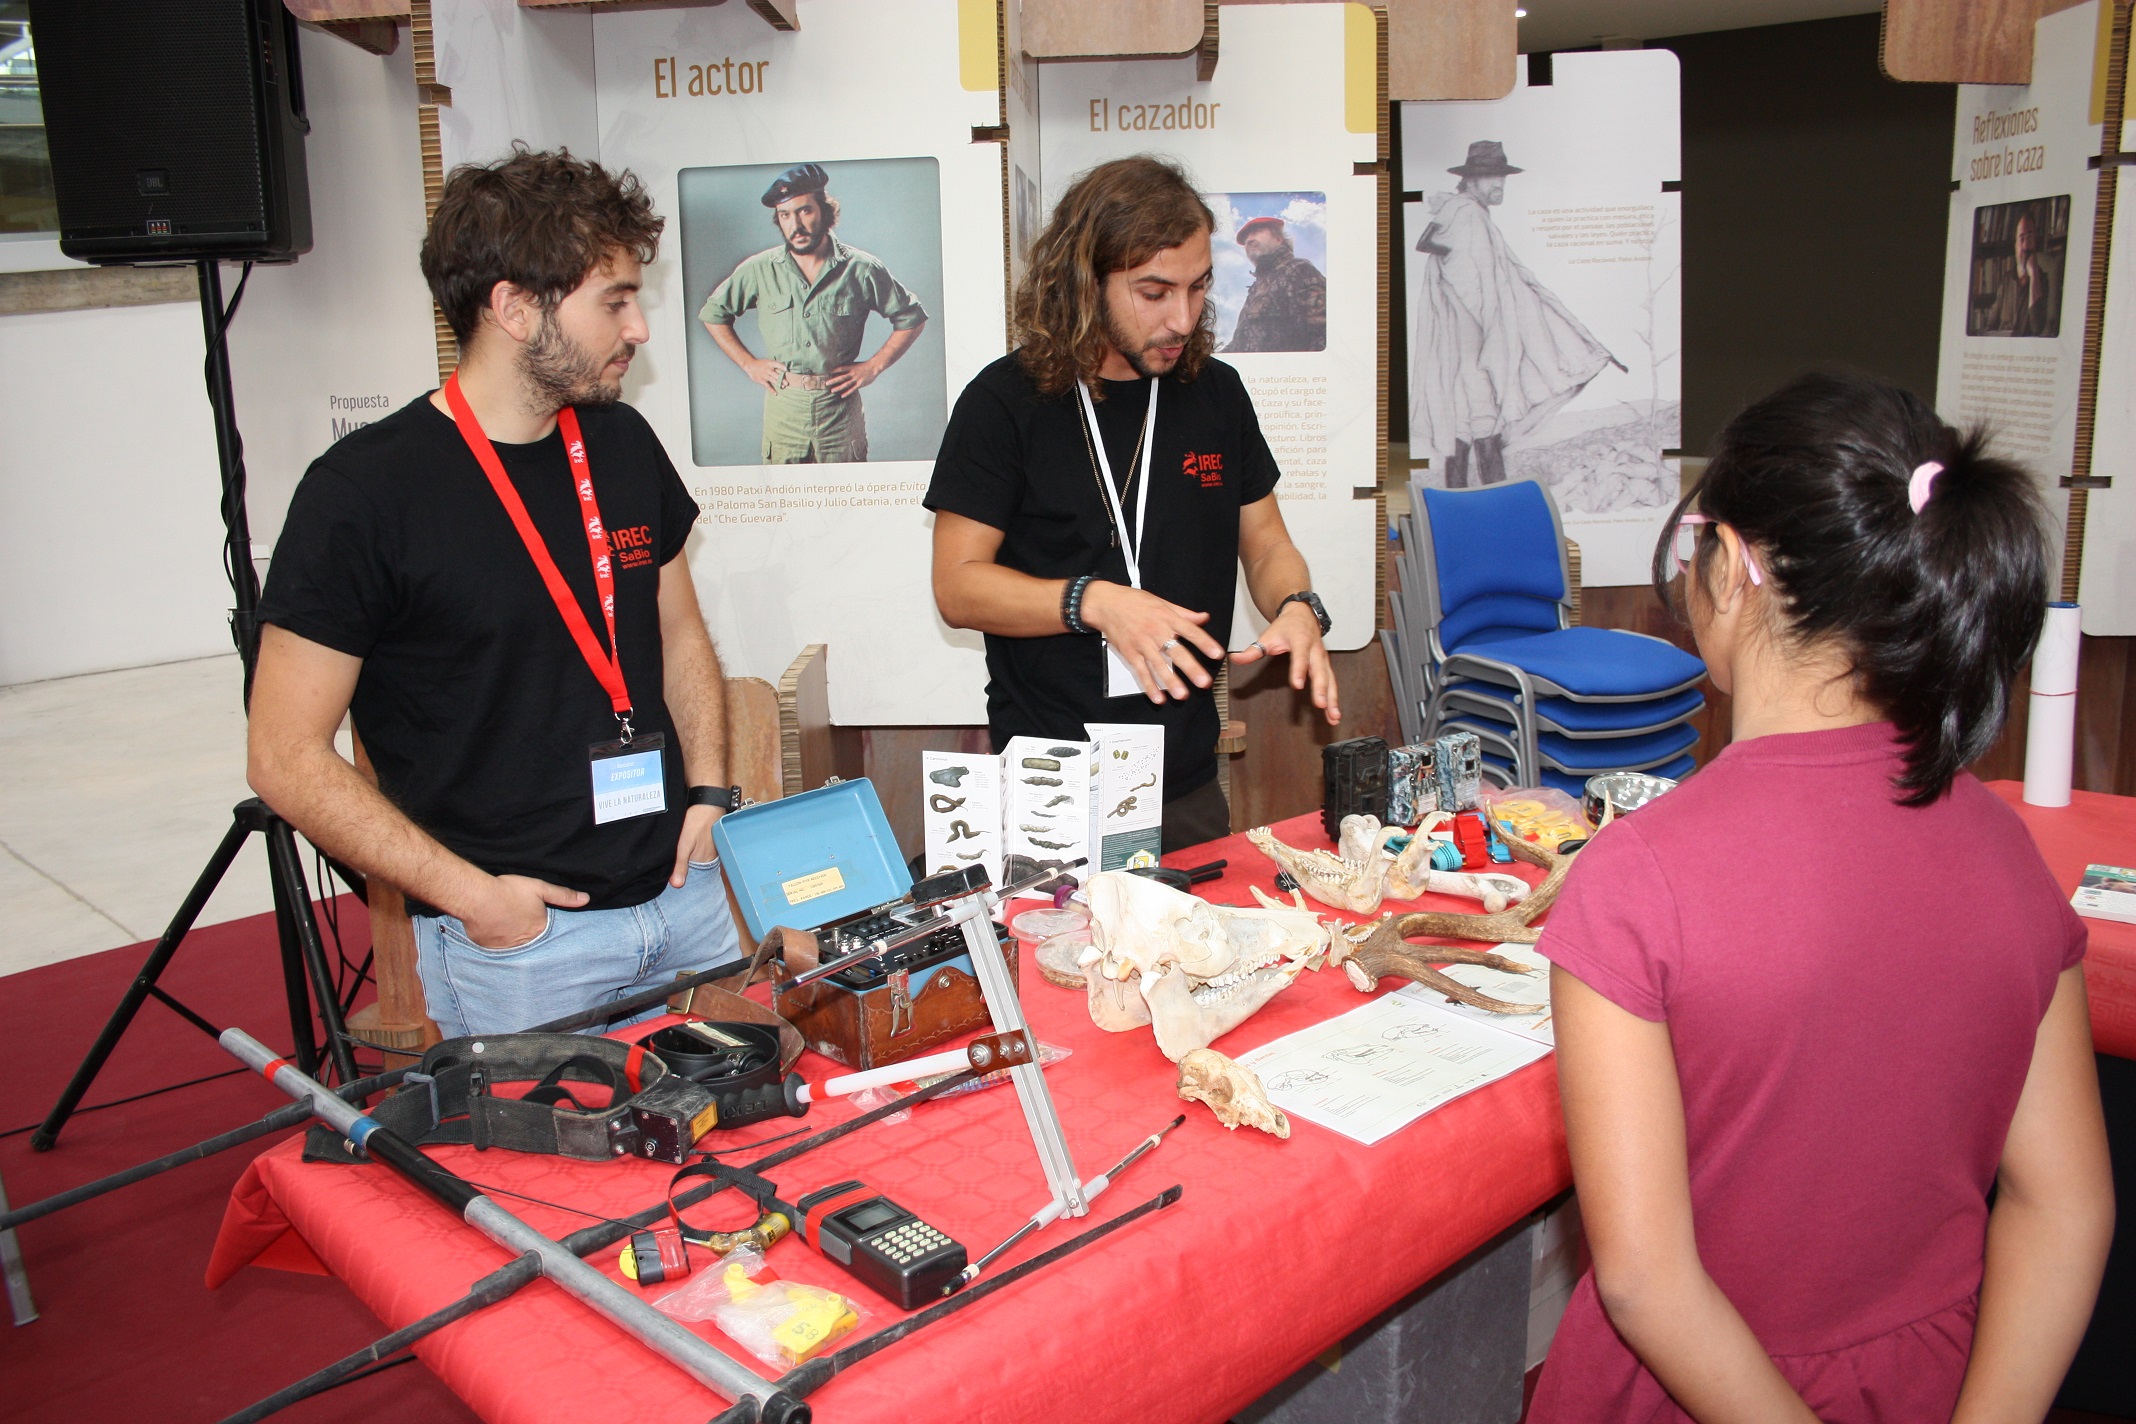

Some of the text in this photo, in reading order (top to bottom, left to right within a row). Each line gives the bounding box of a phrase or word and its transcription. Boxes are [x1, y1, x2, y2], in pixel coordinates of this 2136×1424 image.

[654, 56, 769, 98] El actor
[1090, 96, 1221, 132] El cazador
[1972, 107, 2038, 144] Reflexiones
[1970, 145, 2044, 181] sobre la caza
[1260, 376, 1309, 384] naturaleza,
[1250, 388, 1278, 396] Ocupó
[1289, 388, 1314, 396] cargo
[330, 394, 389, 411] Propuesta
[1262, 399, 1282, 407] Caza
[1304, 398, 1326, 406] face-
[1304, 411, 1326, 419] prin-
[1301, 422, 1326, 430] Escri-
[1198, 454, 1222, 470] IREC
[694, 482, 926, 496] En 1980 Patxi Andión interpreó la ópera Evita
[716, 500, 756, 510] Paloma
[758, 500, 776, 509] San
[780, 498, 814, 508] Basilio
[816, 500, 822, 509] y
[824, 498, 848, 507] Julio
[850, 497, 892, 506] Catania,
[910, 496, 918, 504] el
[696, 516, 712, 524] del
[612, 526, 652, 550] IREC
[619, 548, 650, 562] SaBio
[611, 768, 645, 781] EXPOSITOR
[598, 790, 660, 810] VIVE LA NATURALEZA
